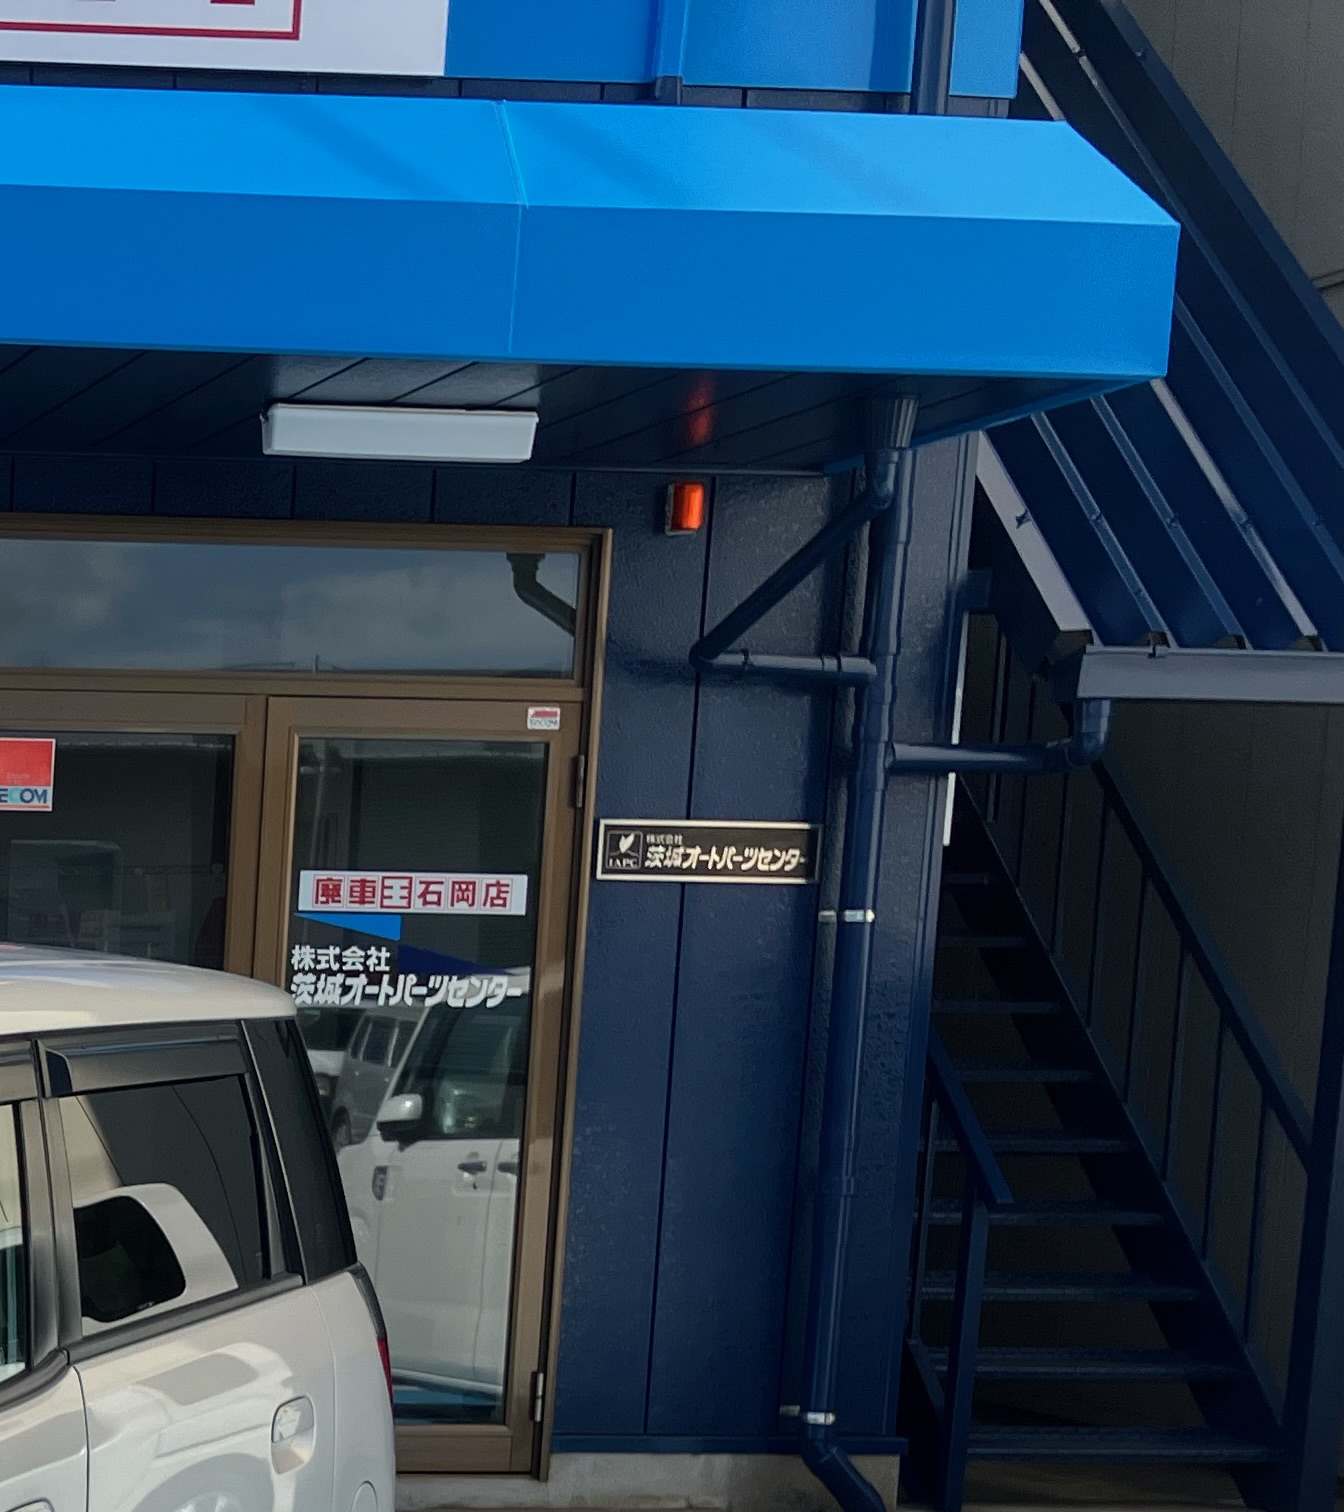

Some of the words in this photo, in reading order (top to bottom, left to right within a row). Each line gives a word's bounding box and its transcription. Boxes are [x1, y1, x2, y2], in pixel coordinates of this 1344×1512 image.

[314, 876, 511, 909] 廃車王石岡店
[291, 944, 391, 972] 株式会社
[290, 972, 523, 1008] 茨城オートパーツセンター
